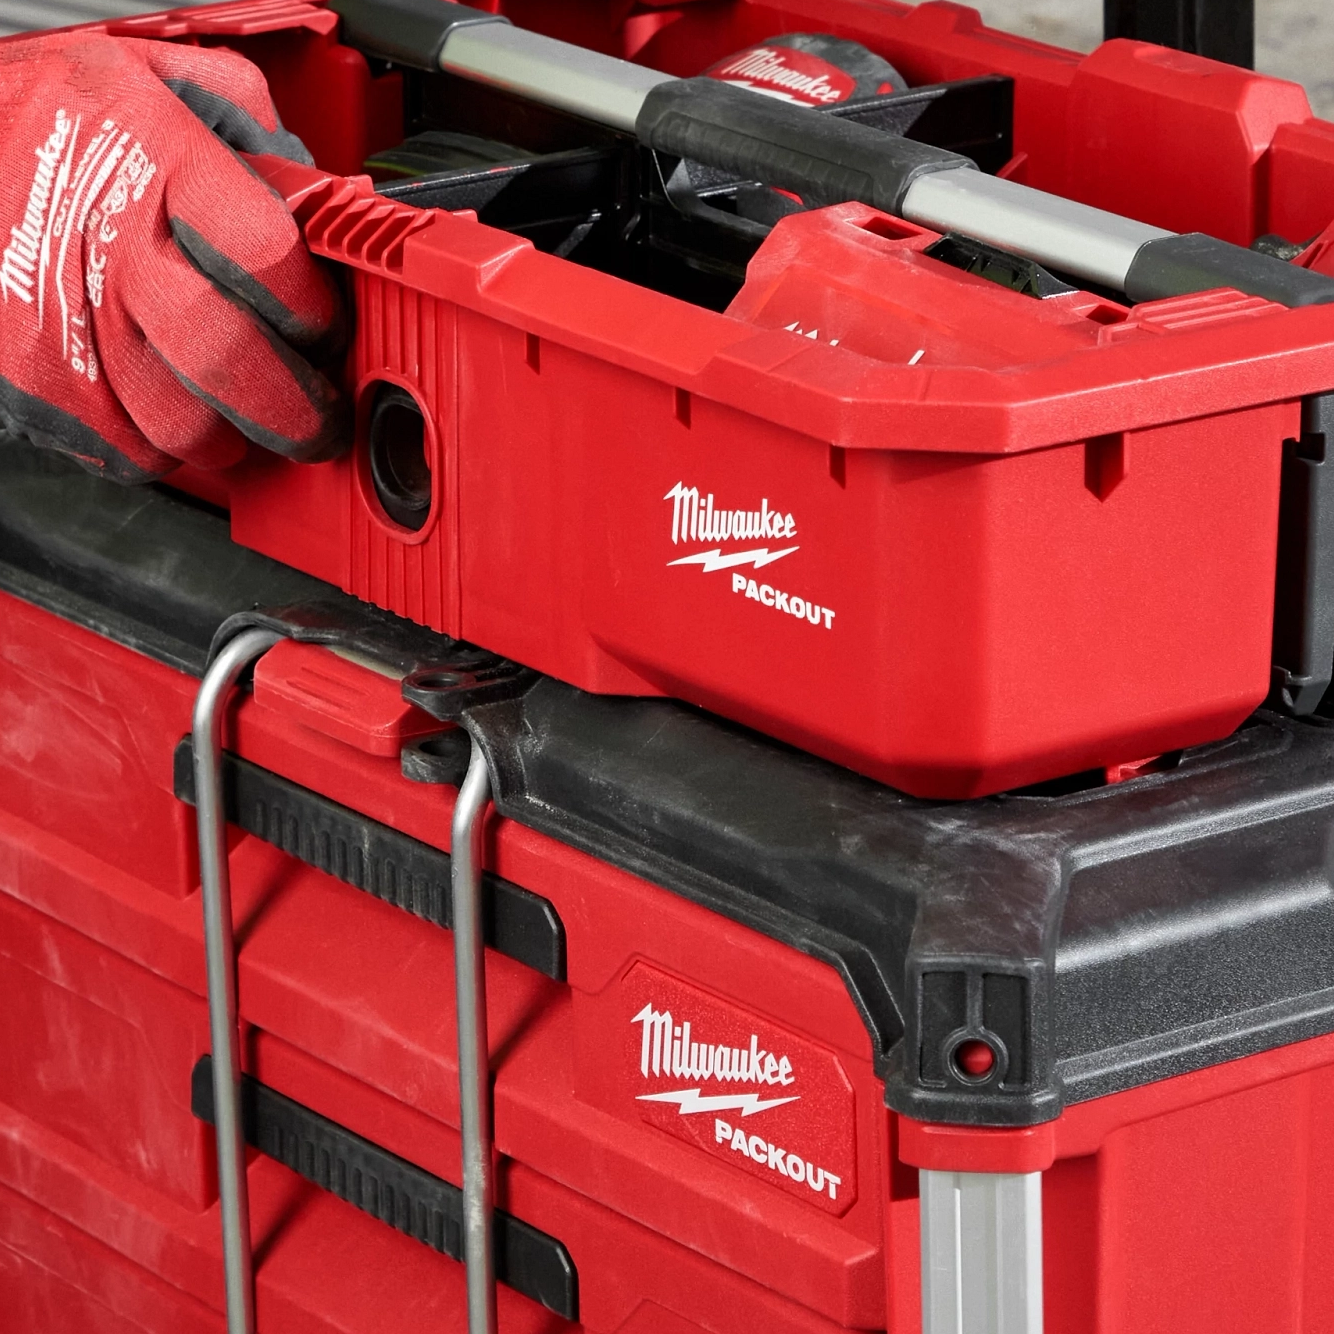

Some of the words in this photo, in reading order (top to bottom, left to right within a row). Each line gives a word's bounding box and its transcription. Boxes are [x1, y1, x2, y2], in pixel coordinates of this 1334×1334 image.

[722, 48, 841, 103] Milwaukee
[53, 196, 71, 237] CUT
[69, 133, 105, 189] LEVEL
[663, 480, 798, 546] Milwaukee
[732, 572, 836, 630] PACKOUT
[630, 1002, 796, 1086] Milwaukee
[714, 1118, 842, 1200] PACKOUT
